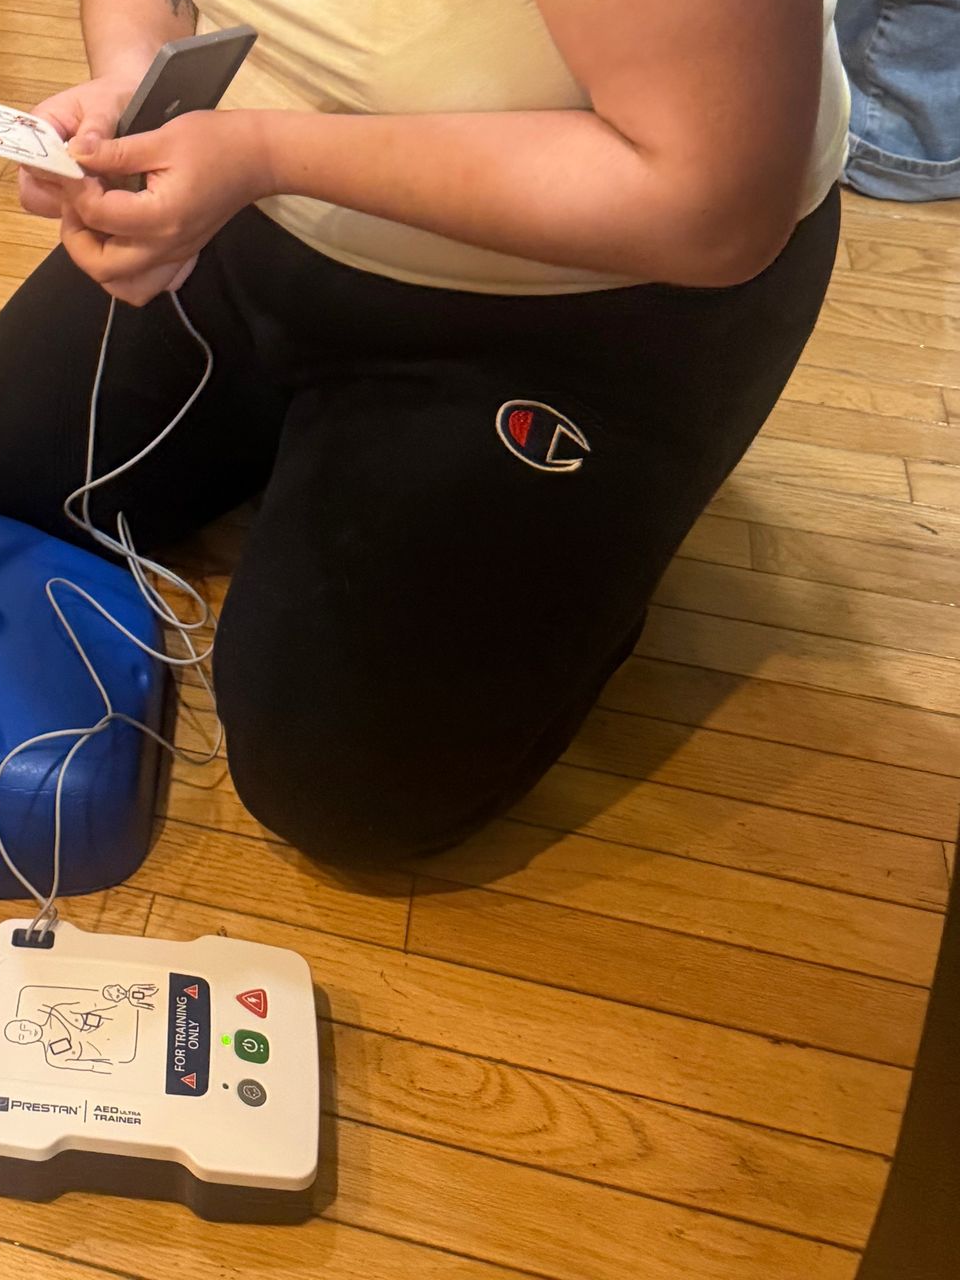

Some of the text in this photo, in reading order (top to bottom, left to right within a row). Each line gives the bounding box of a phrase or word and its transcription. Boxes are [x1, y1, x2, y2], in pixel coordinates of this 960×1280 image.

[174, 996, 188, 1072] FOR TRAINING
[187, 1020, 200, 1049] ONLY
[10, 1100, 80, 1115] PRESTAN
[94, 1105, 119, 1114] AED
[93, 1113, 141, 1125] TRAINER
